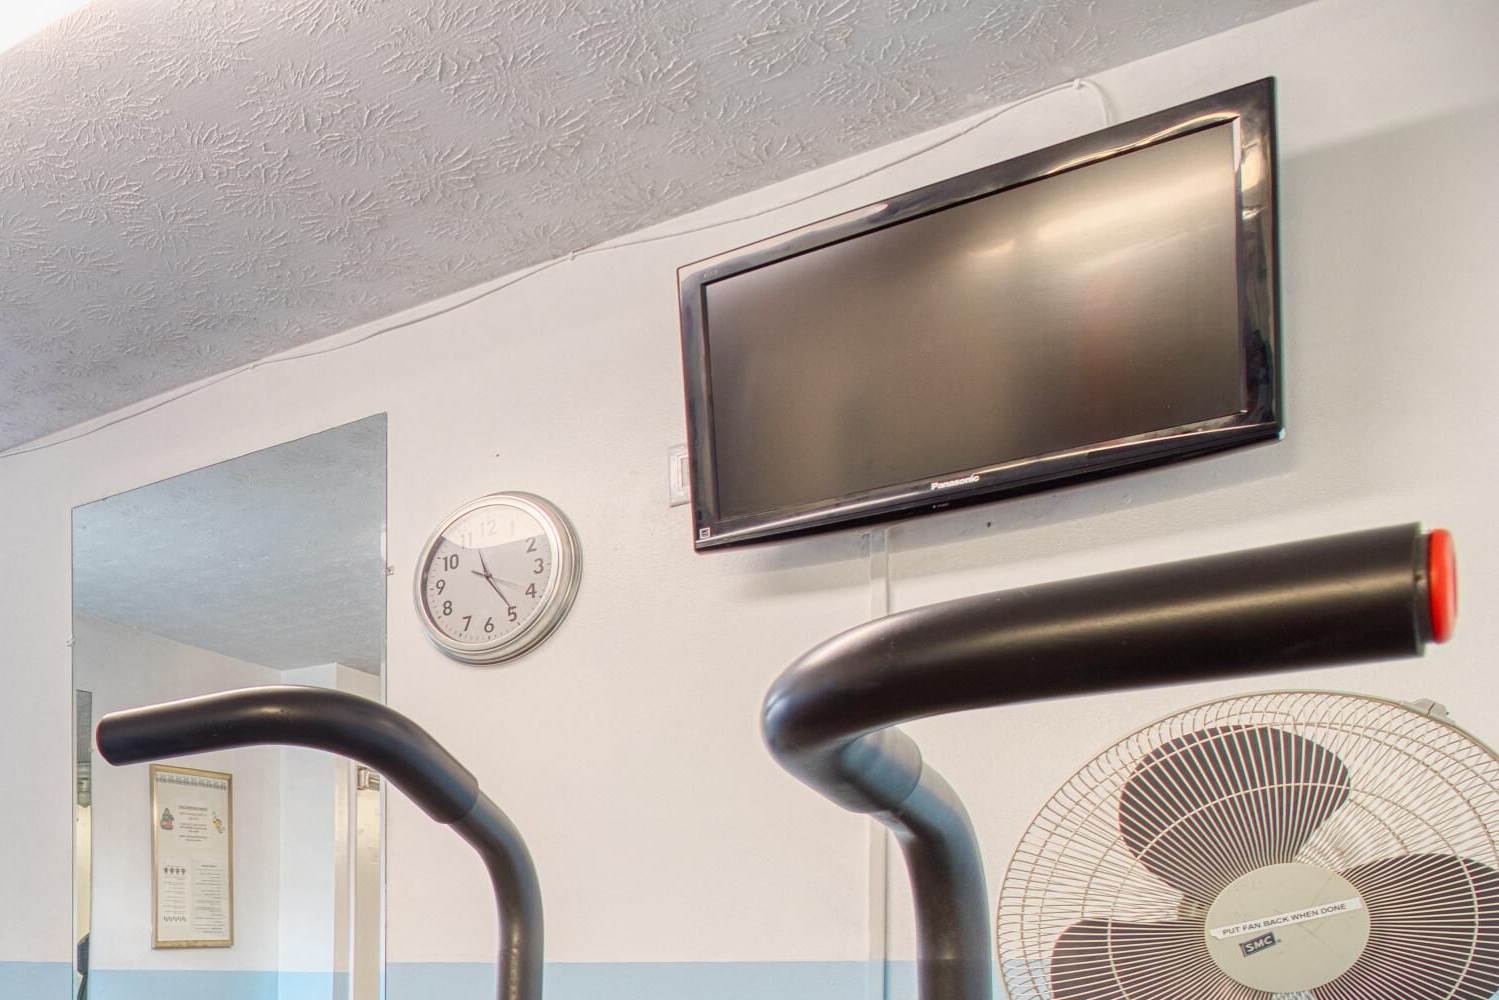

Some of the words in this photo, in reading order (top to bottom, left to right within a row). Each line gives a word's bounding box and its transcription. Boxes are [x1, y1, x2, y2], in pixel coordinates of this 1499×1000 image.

[931, 473, 980, 490] Panasonic
[480, 520, 496, 538] 12
[509, 521, 515, 536] 1
[460, 533, 473, 547] 11
[525, 537, 537, 553] 2
[443, 554, 459, 571] 10
[533, 558, 544, 574] 3
[436, 579, 445, 595] 9
[525, 583, 537, 598] 4
[443, 601, 453, 616] 8
[507, 606, 517, 621] 5
[463, 616, 472, 631] 7
[484, 617, 494, 632] 6
[1222, 926, 1240, 936] PUT
[1242, 922, 1261, 932] FAN
[1263, 916, 1289, 927] BACK
[1290, 909, 1319, 921] WHEN
[1321, 903, 1347, 915] DONE
[1244, 935, 1274, 952] SMC
